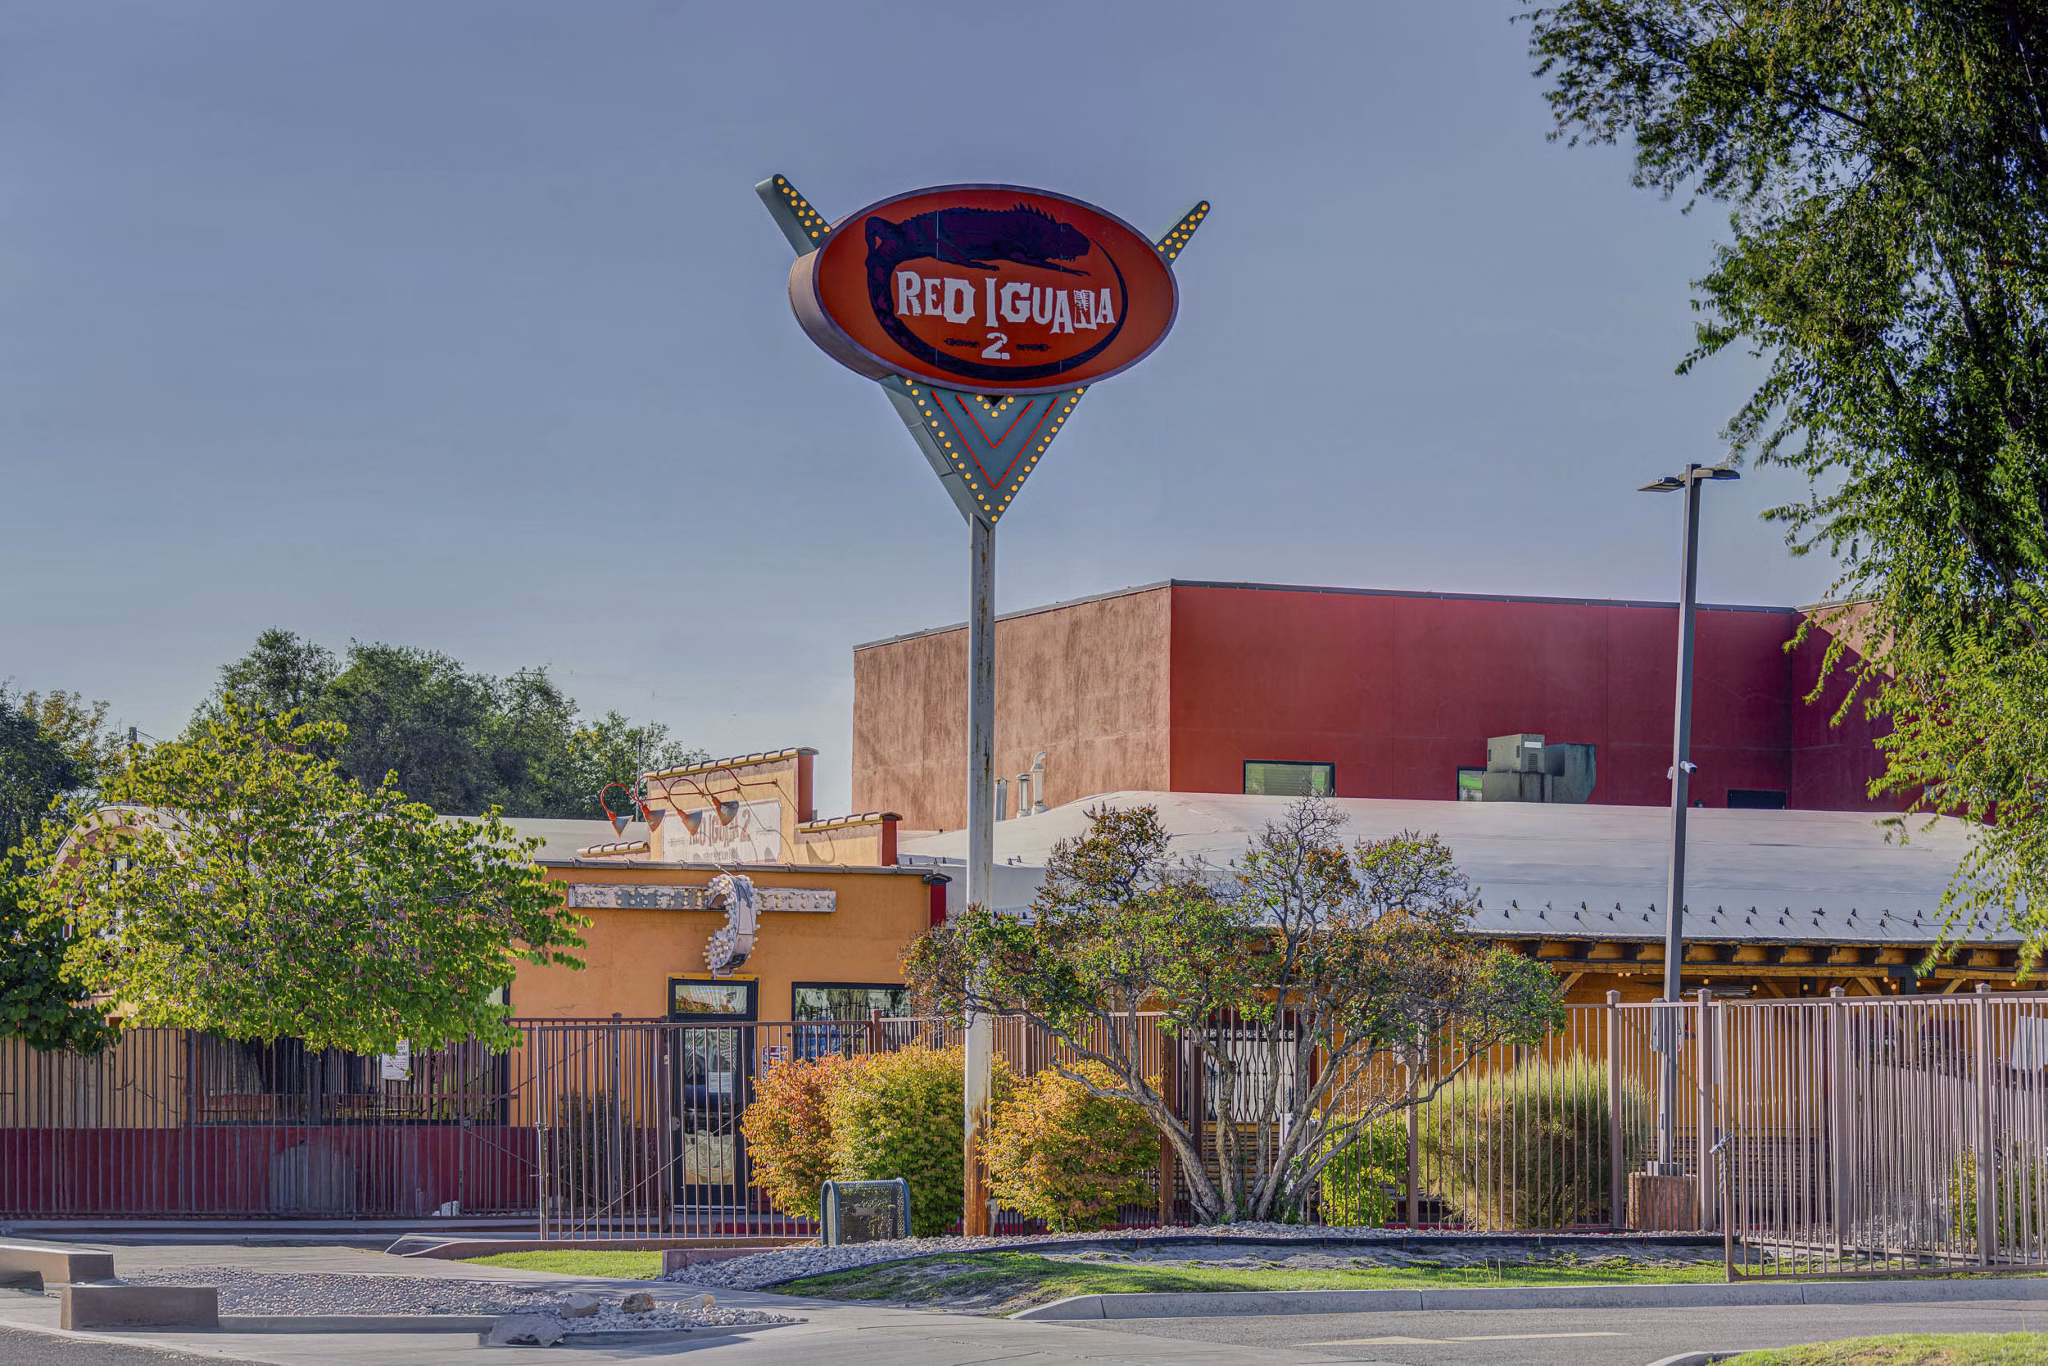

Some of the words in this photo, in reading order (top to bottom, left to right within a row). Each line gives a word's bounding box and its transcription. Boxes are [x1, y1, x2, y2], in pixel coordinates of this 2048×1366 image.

[896, 271, 976, 324] RED
[985, 277, 1116, 334] IGUANA
[981, 332, 1010, 360] 2
[741, 808, 751, 842] 2
